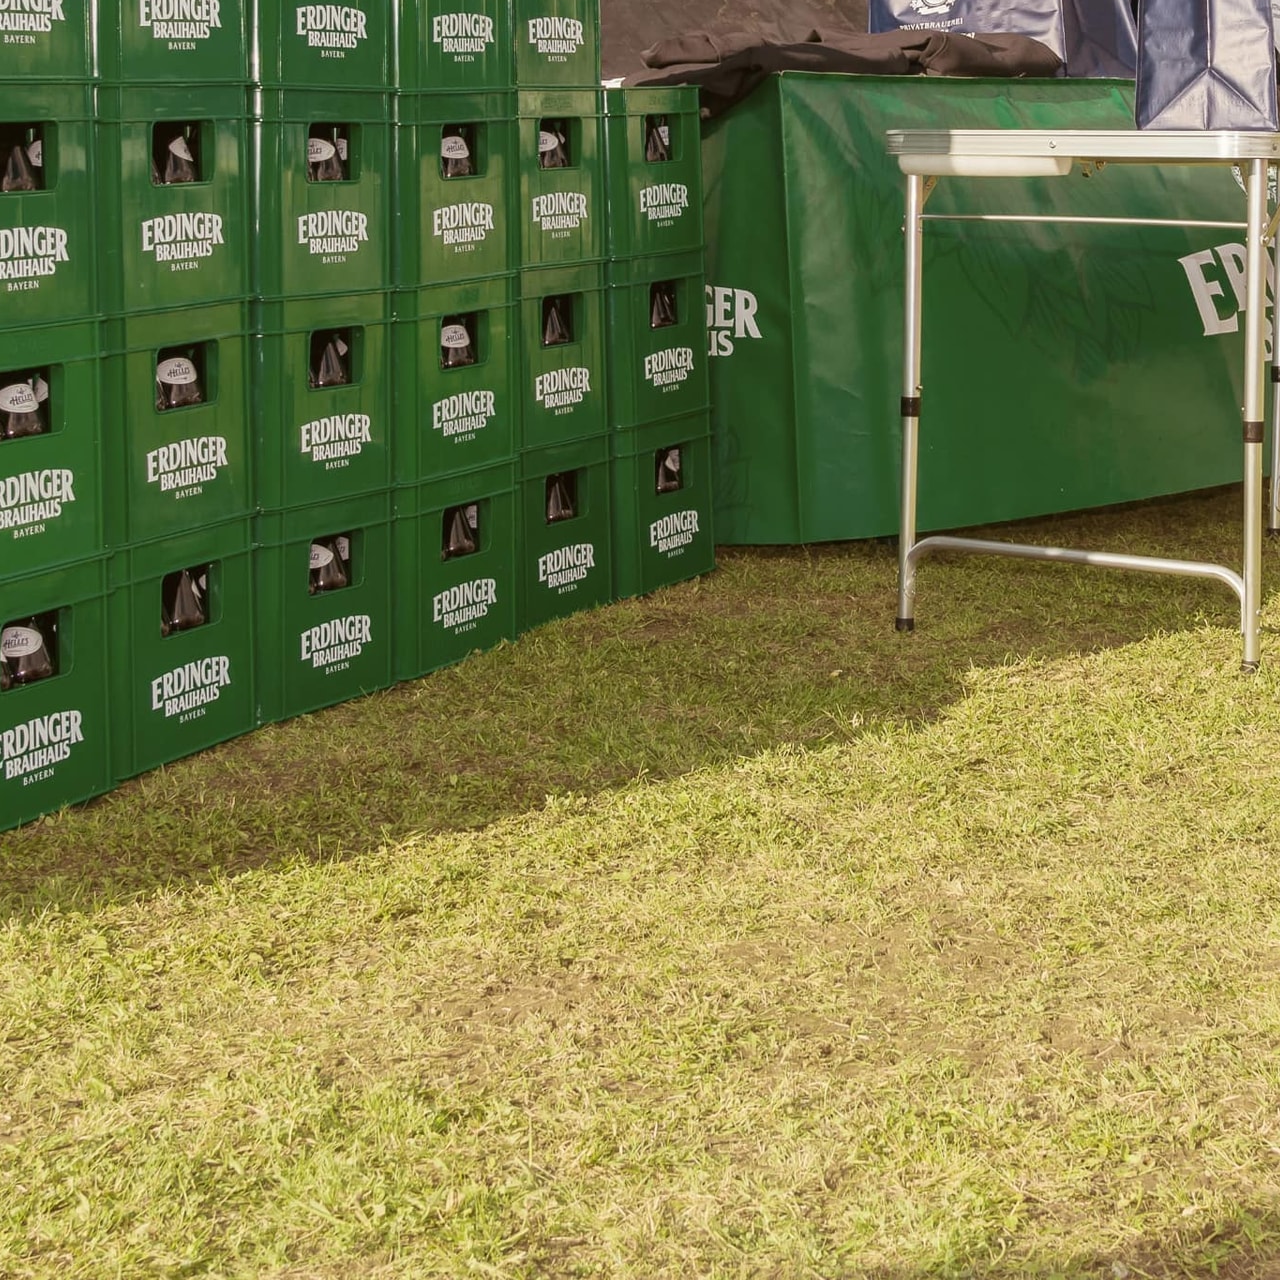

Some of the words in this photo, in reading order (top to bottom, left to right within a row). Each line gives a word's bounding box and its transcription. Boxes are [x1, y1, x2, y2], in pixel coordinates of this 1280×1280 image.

[528, 16, 585, 45] ERDINGER
[537, 39, 577, 53] BRAUHAUS
[638, 183, 689, 213] ERDINGER
[647, 203, 682, 221] BRAUHAUS
[7, 279, 39, 291] BAYERN
[649, 510, 700, 547] ERDINGER
[658, 529, 693, 553] BRAUHAUS
[5, 739, 71, 780] BRAUHAUS
[23, 766, 54, 786] BAYERN
